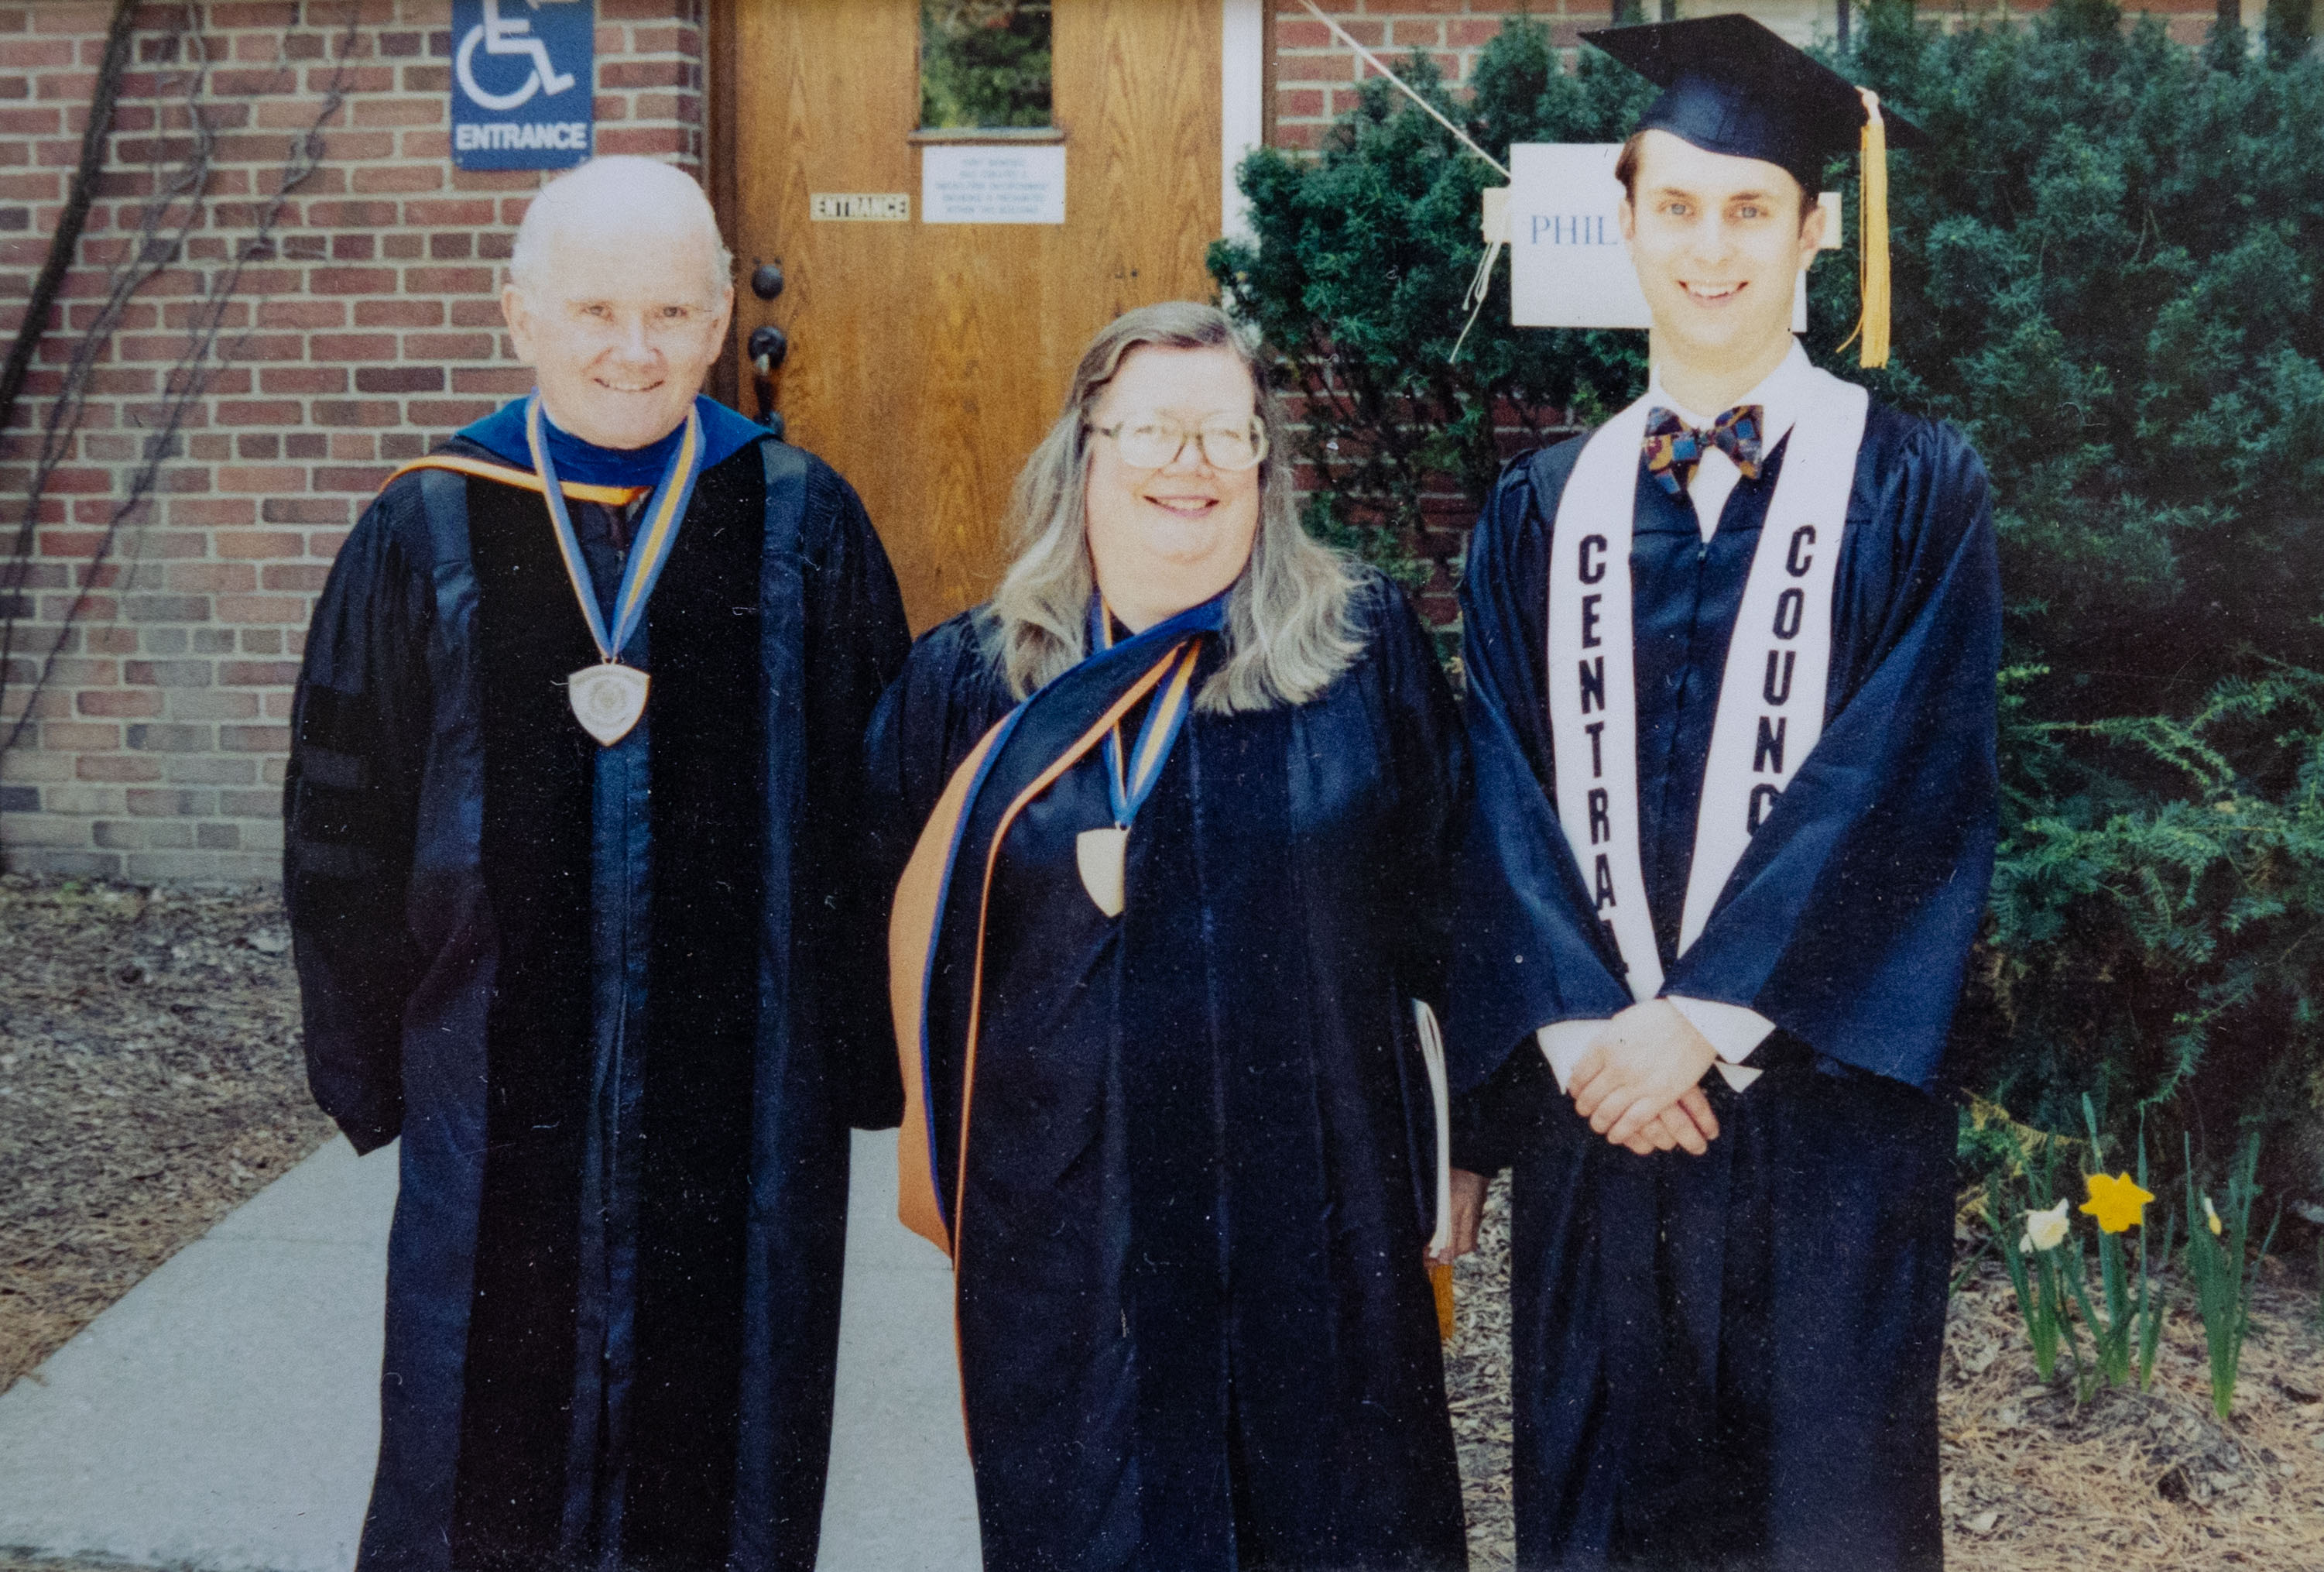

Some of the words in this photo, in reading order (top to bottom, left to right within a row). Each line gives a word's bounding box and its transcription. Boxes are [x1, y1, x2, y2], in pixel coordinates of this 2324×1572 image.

[456, 122, 588, 150] ENTRANCE
[1531, 215, 1618, 245] PHIL
[1578, 534, 1629, 973] CENTRA
